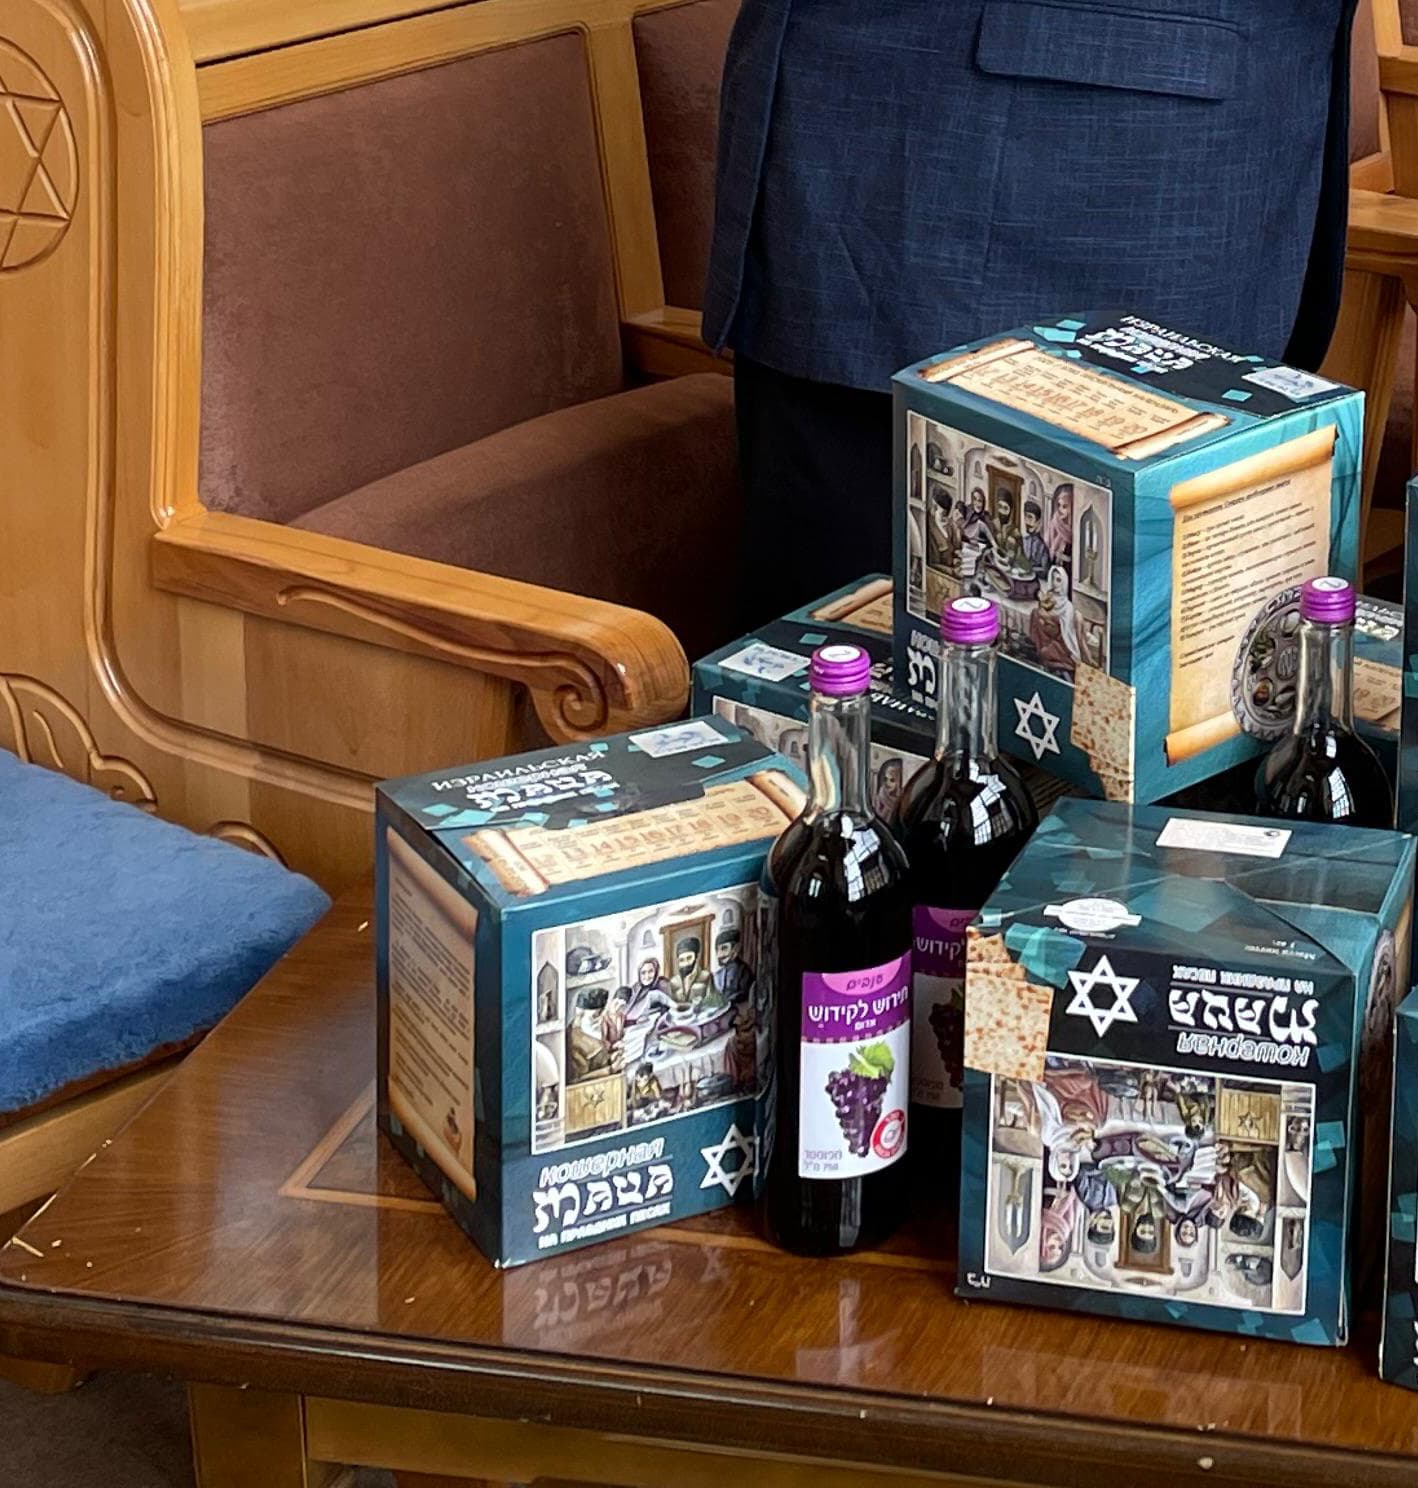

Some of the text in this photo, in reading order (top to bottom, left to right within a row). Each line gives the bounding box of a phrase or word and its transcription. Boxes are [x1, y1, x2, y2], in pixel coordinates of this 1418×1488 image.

[917, 937, 966, 961] קידוש
[808, 999, 869, 1026] לקידוש
[1168, 988, 1320, 1047] МАЦА
[532, 1164, 674, 1233] МАЦА
